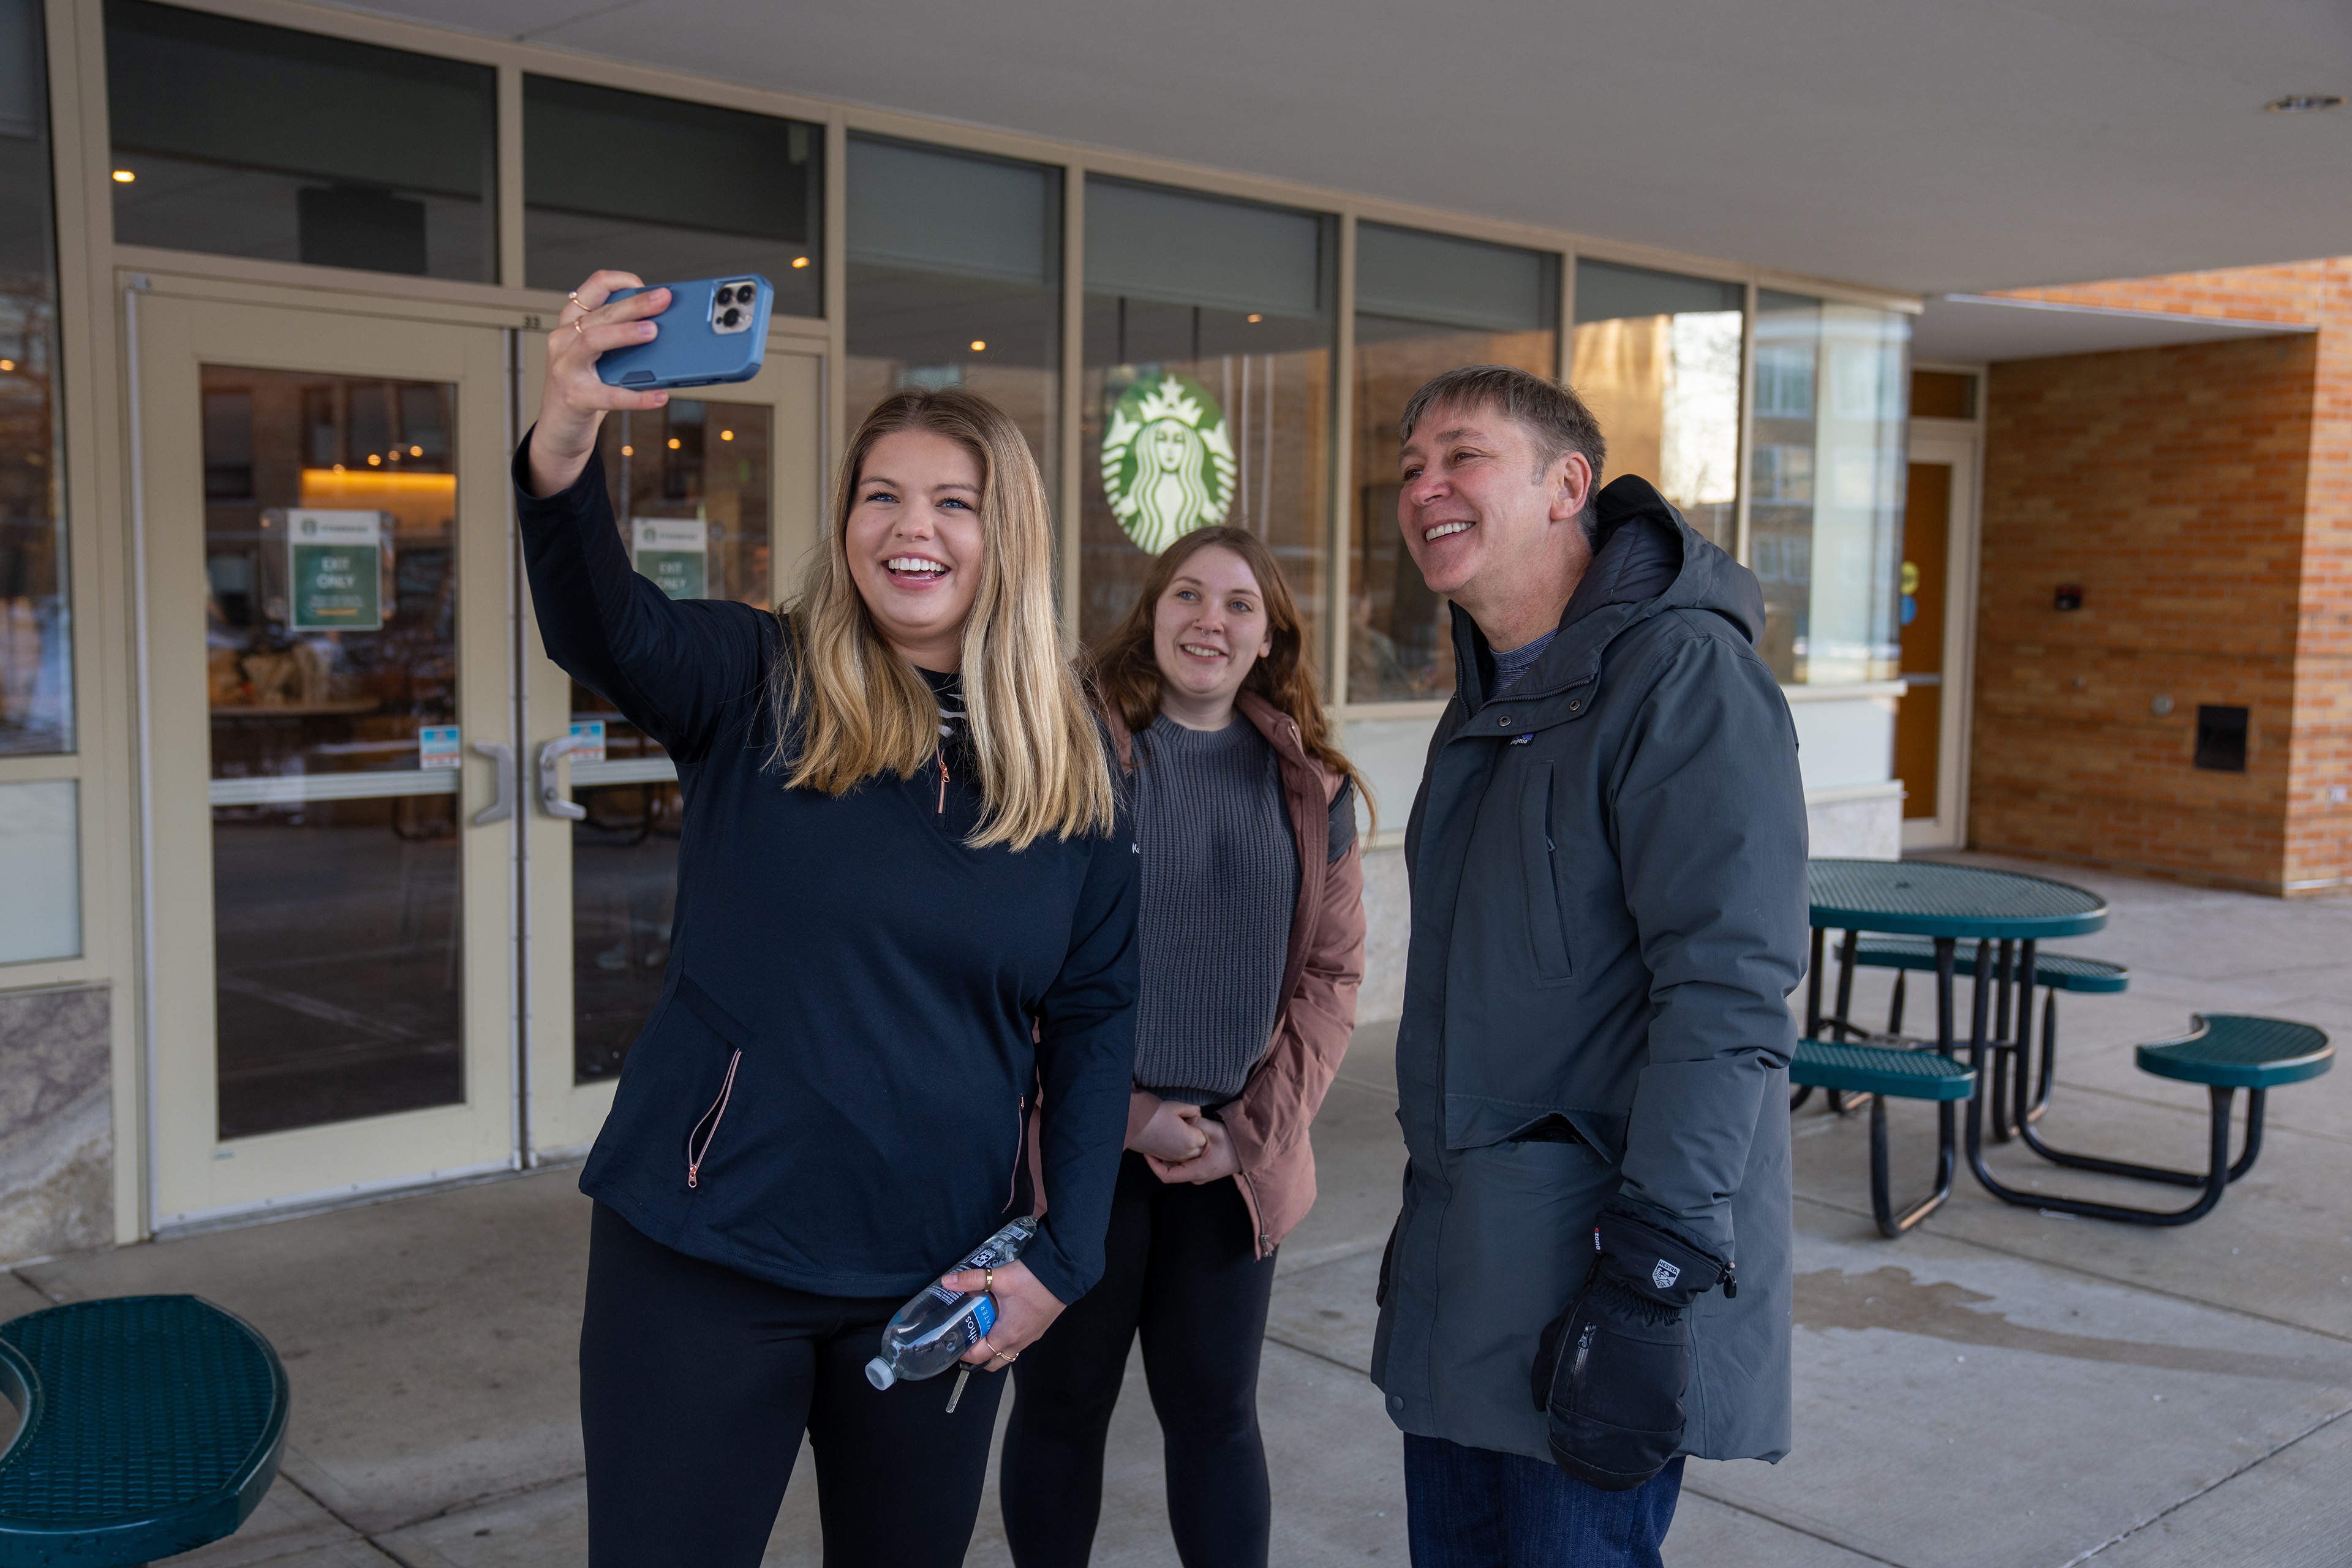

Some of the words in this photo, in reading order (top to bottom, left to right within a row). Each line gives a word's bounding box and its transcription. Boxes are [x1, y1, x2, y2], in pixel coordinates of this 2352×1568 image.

[322, 556, 350, 572] EXIT
[658, 561, 682, 575] EXIT
[316, 573, 355, 589] ONLY
[1659, 1261, 1678, 1274] HESTRA
[965, 1316, 978, 1343] ethos
